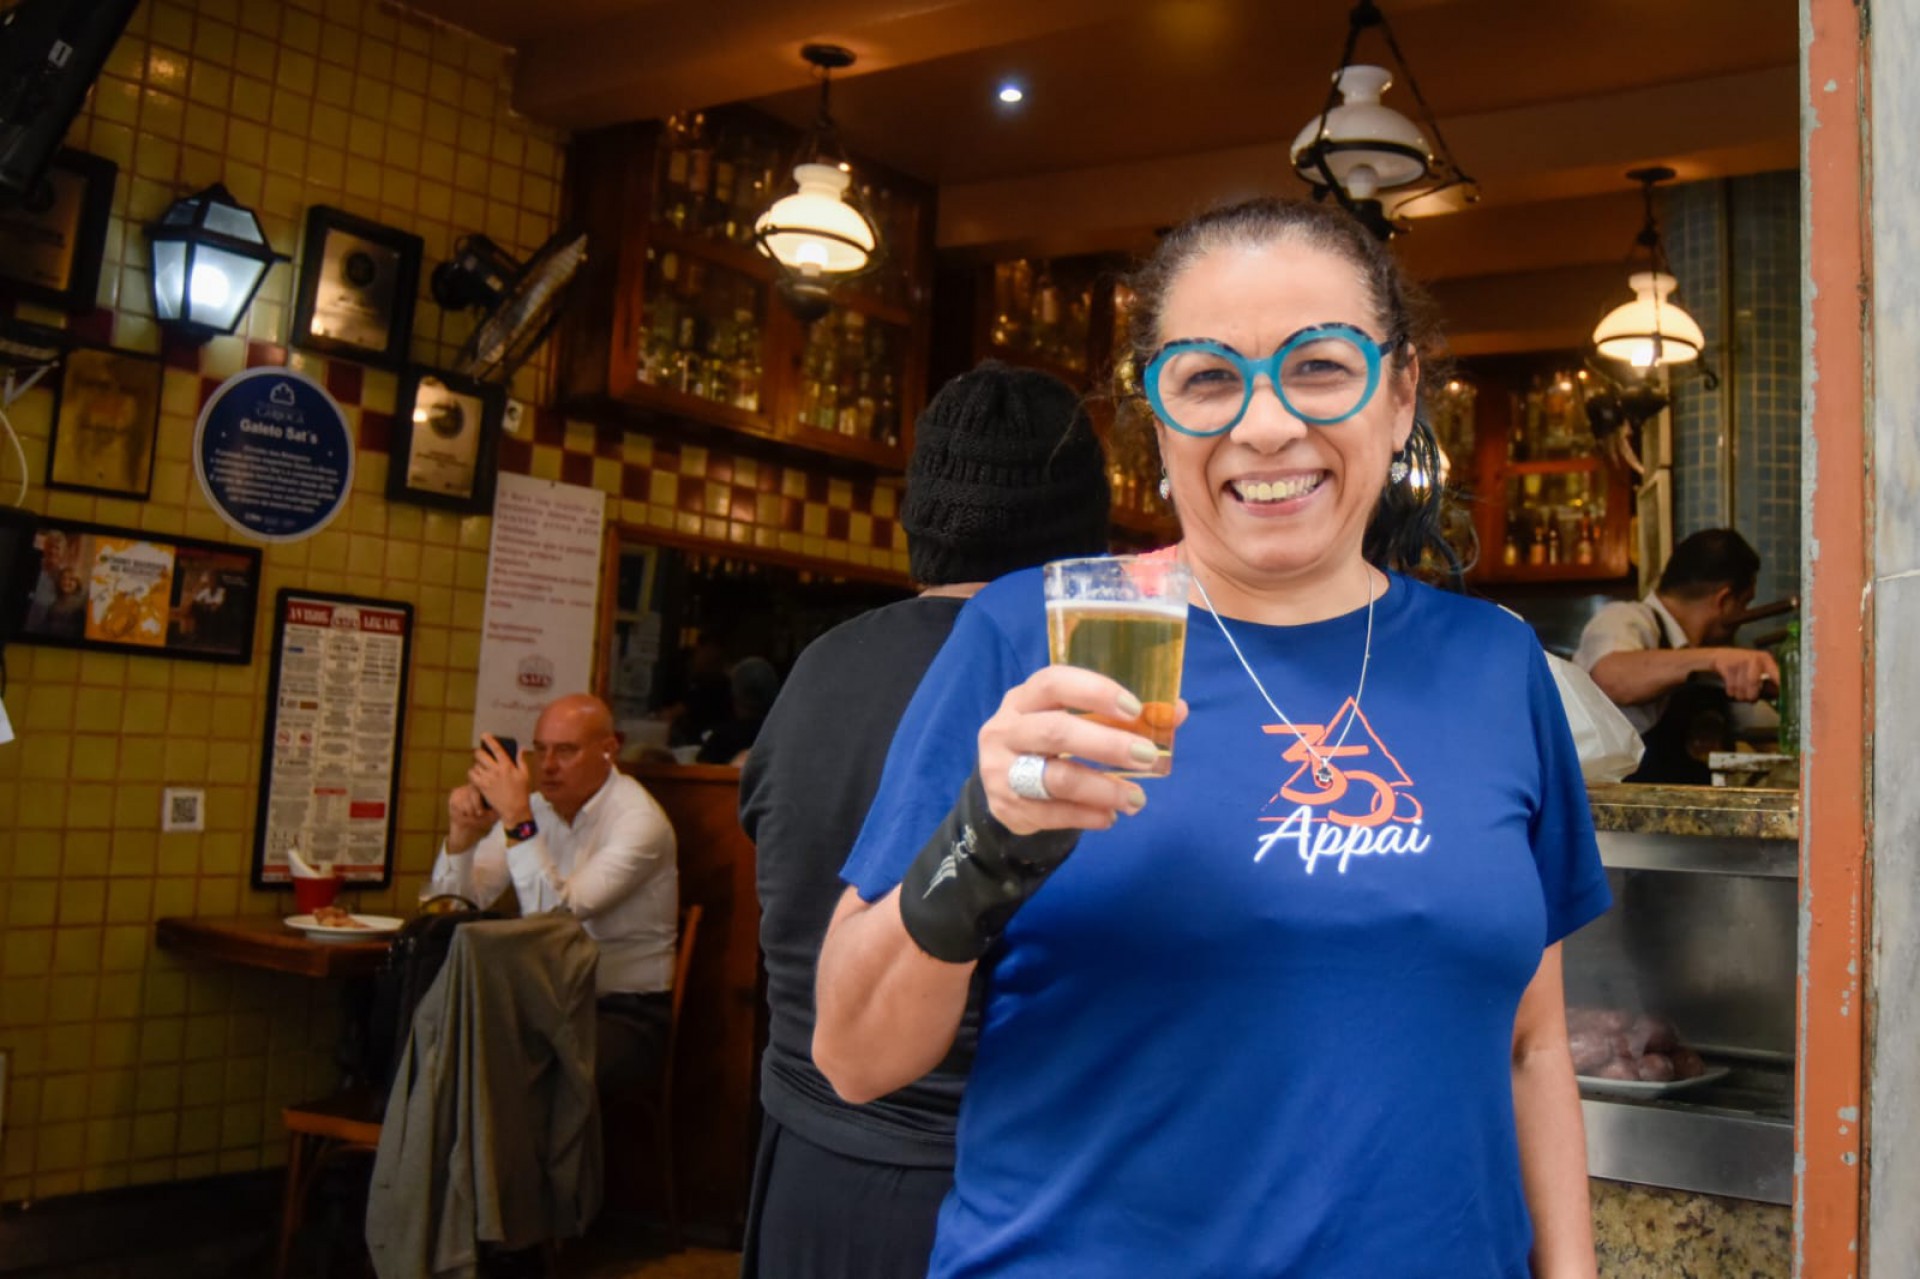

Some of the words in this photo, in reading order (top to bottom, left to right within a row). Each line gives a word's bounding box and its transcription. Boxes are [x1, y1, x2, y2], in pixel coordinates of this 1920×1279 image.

[240, 417, 283, 438] Galeto
[1261, 723, 1396, 828] 35
[1253, 804, 1432, 875] Appai
